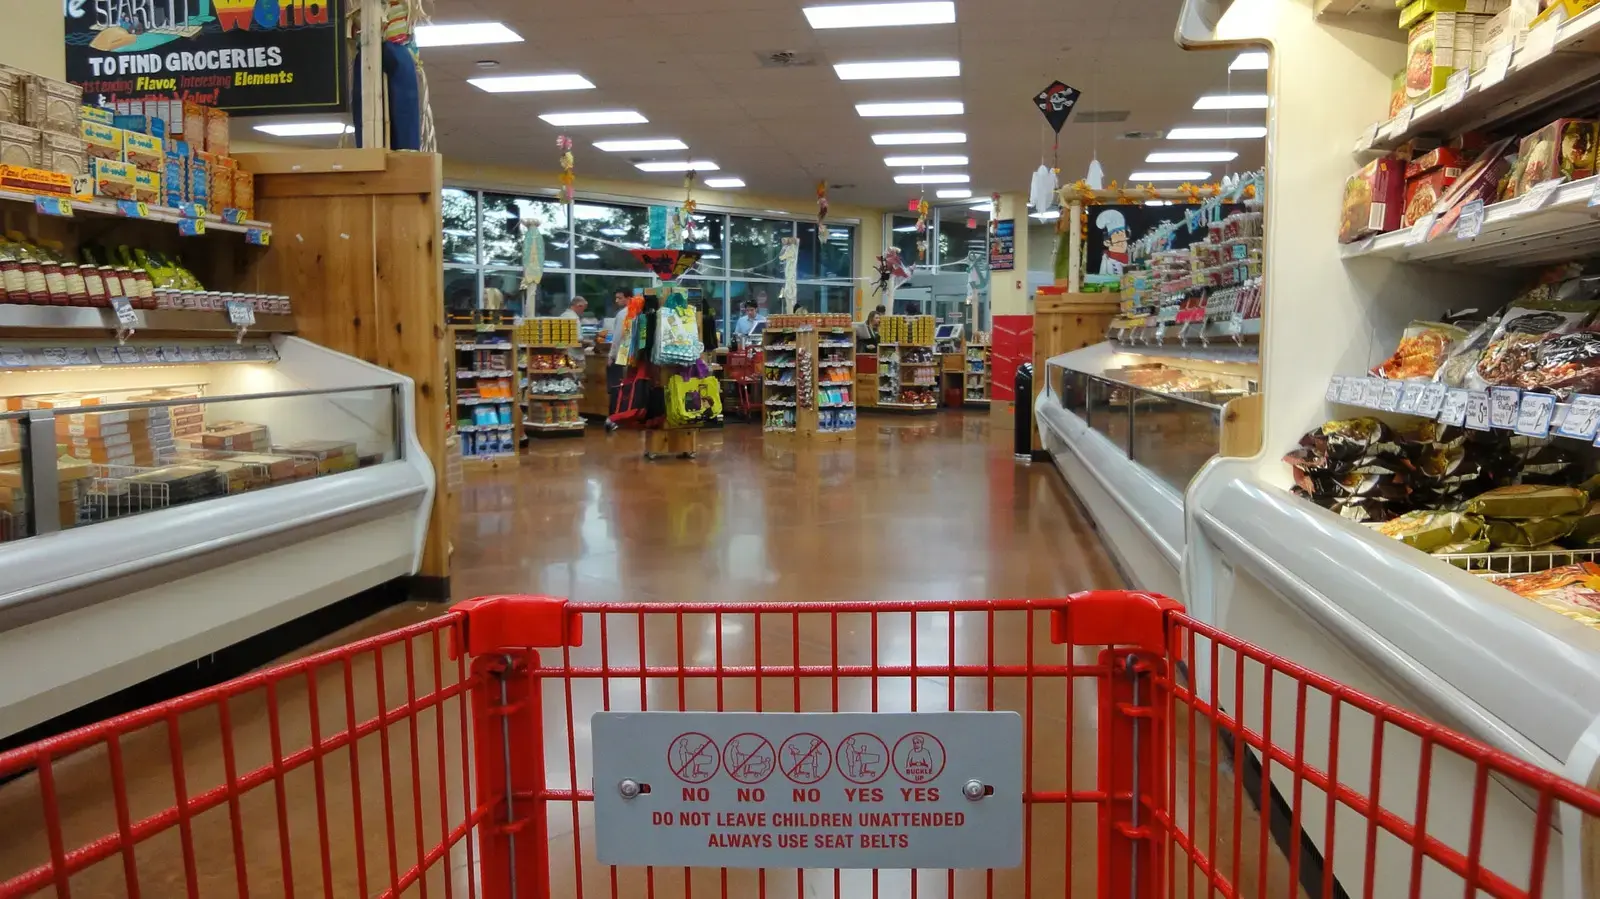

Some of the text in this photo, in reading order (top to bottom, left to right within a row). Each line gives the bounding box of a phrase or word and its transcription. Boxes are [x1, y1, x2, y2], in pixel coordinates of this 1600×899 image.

[89, 46, 283, 76] TO FIND GROCERIES
[136, 76, 178, 92] Flavor,
[180, 74, 231, 89] Interesting
[234, 71, 294, 87] Elements
[682, 788, 940, 802] NO NO NO YES YES
[652, 812, 965, 827] DO NOT LEAVE CHILDREN UNATTENDED
[708, 834, 909, 849] ALWAYS USE SEAT BELTS
